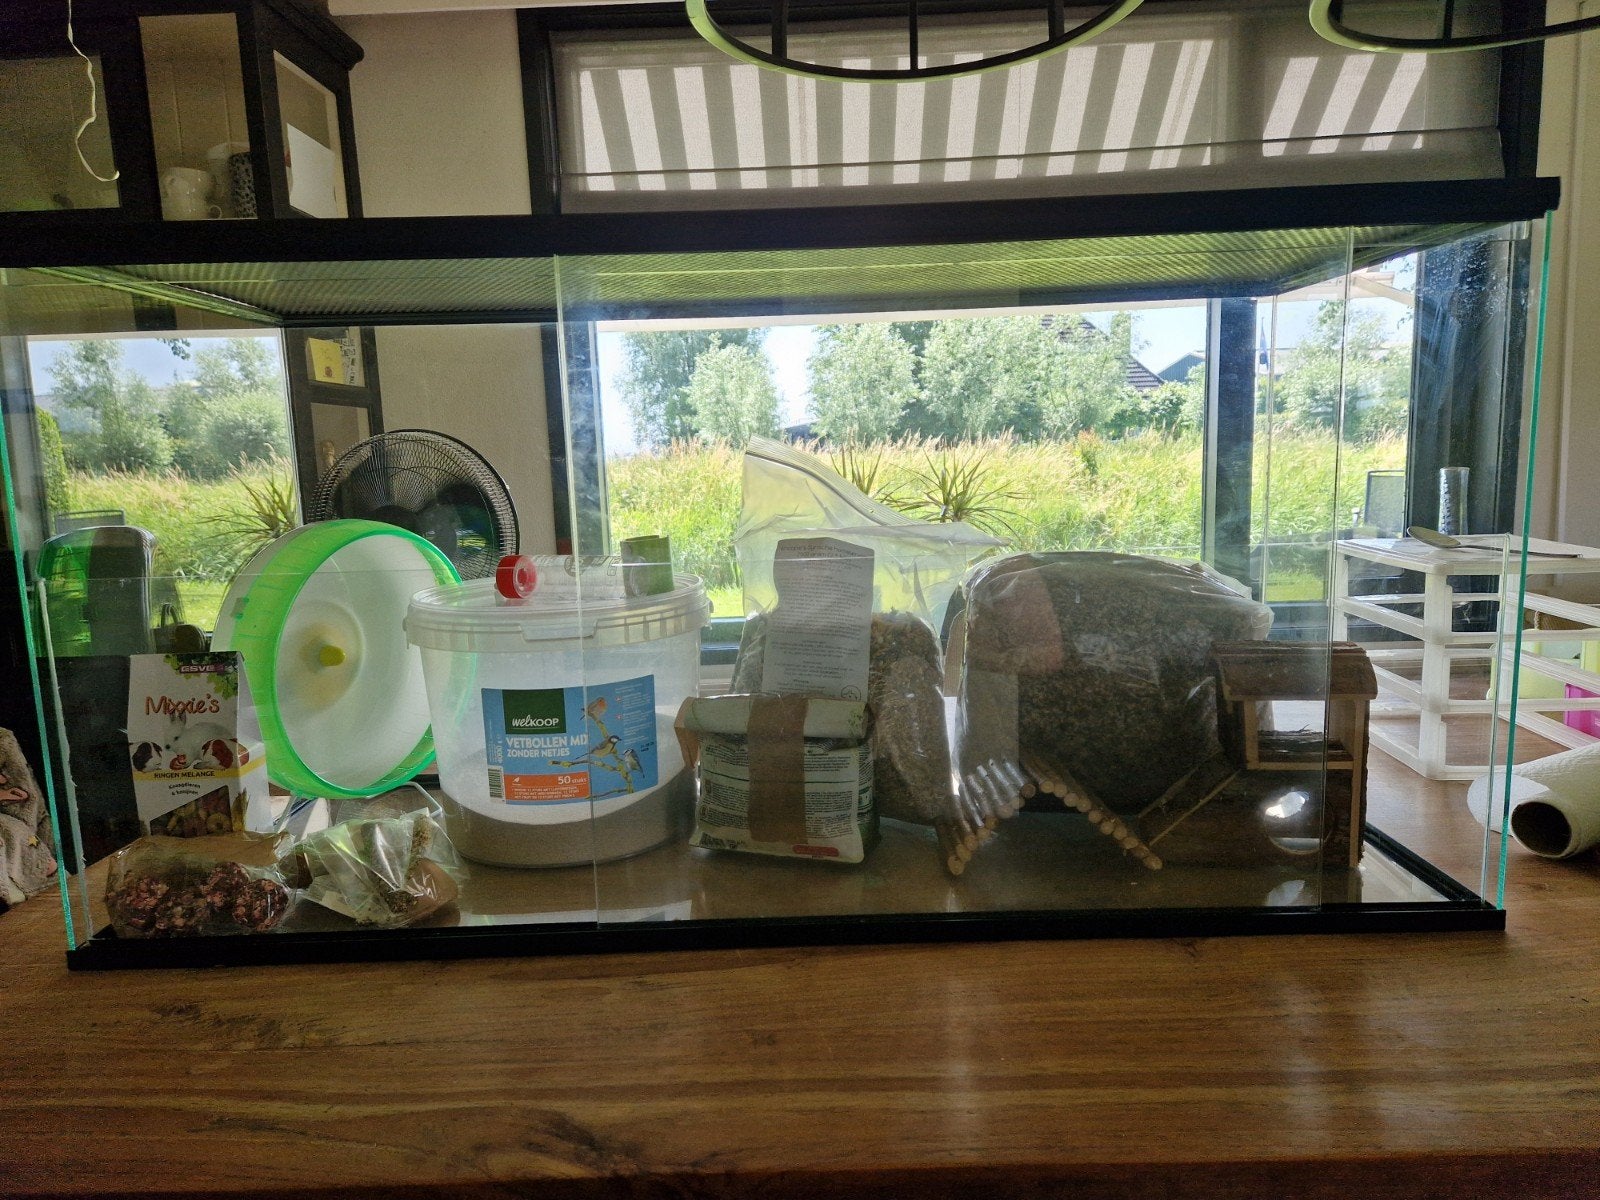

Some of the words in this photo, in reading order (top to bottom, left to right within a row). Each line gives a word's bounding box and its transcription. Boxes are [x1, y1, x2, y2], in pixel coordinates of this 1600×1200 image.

[145, 693, 221, 716] Mixxie's
[505, 736, 568, 748] VETBOLLEN
[507, 749, 540, 758] ZONDER
[541, 747, 570, 757] NETJES
[558, 775, 571, 785] 50
